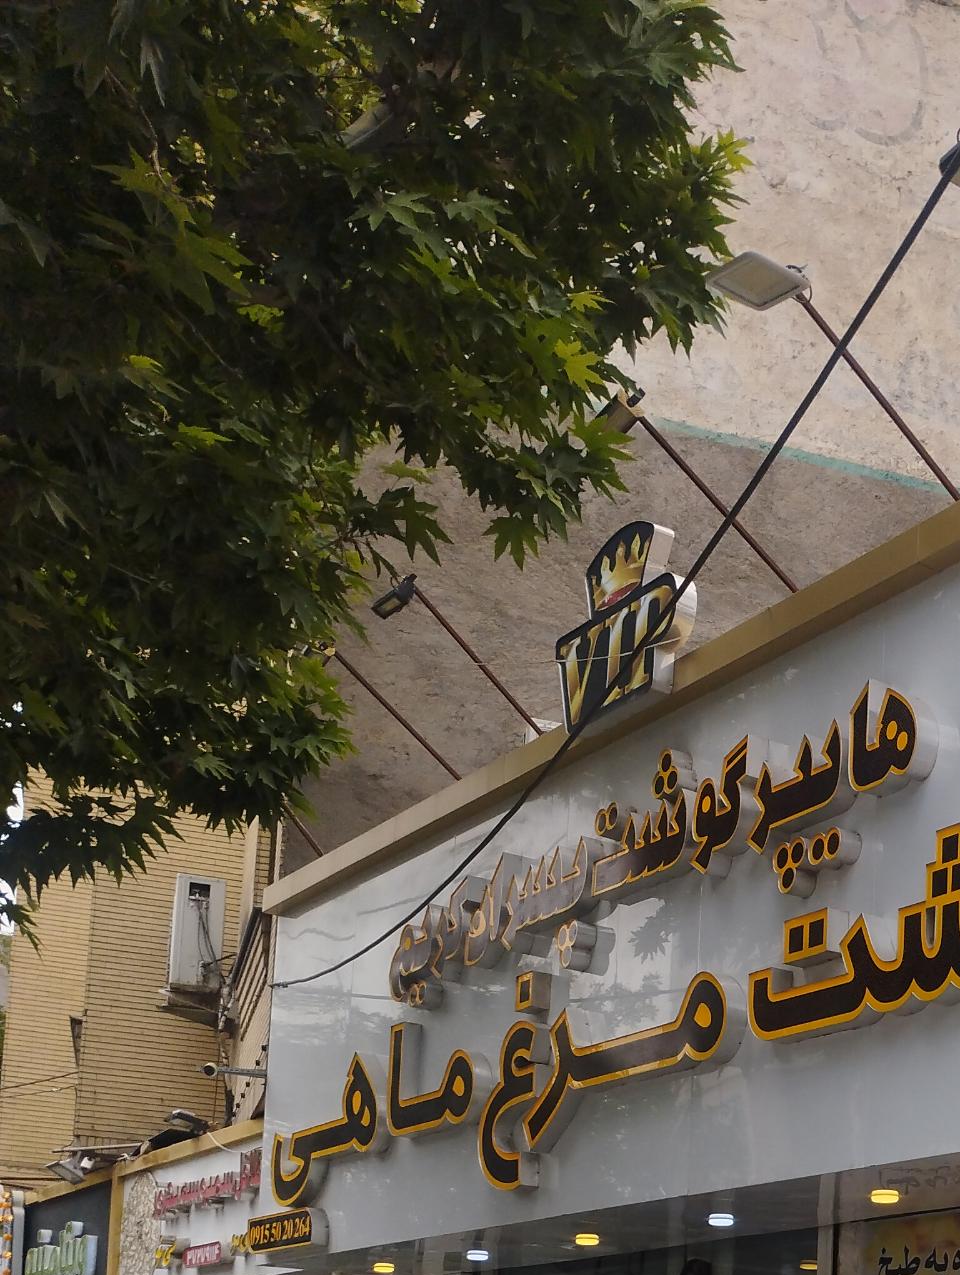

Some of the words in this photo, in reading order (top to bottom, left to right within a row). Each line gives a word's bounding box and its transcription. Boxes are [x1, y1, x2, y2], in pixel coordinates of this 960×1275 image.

[560, 585, 674, 726] VIP
[593, 735, 749, 897] گوشت
[746, 680, 919, 894] هایپر
[270, 1021, 474, 1207] ماهی
[479, 970, 727, 1191] مرغ
